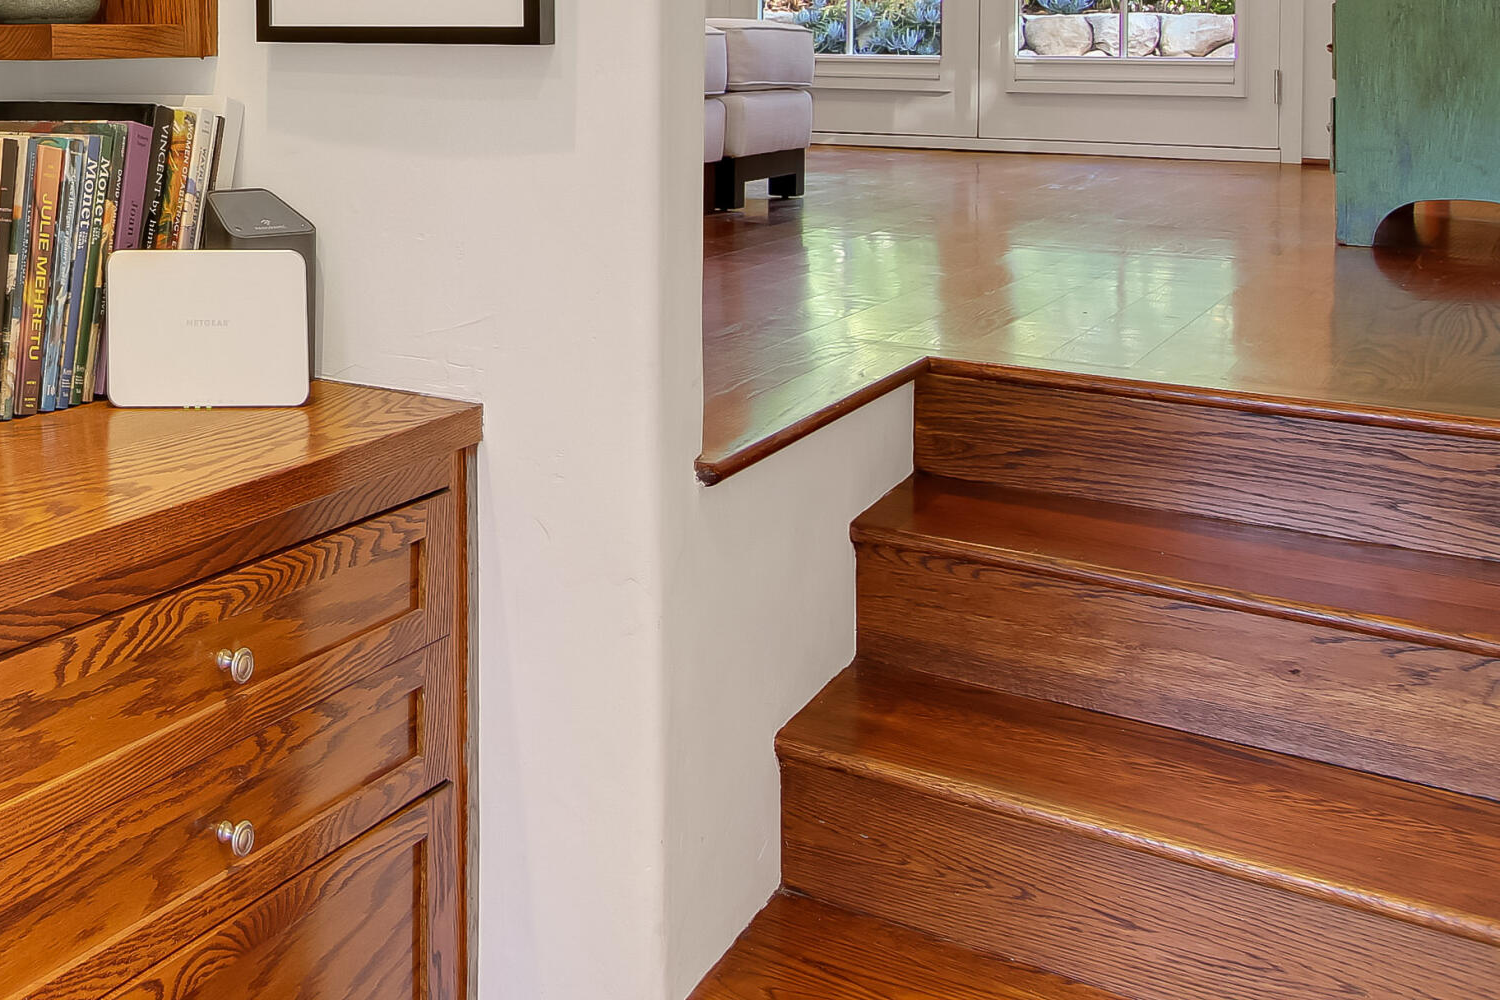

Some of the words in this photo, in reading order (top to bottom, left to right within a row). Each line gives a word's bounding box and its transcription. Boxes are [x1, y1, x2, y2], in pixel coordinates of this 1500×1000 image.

[154, 124, 170, 199] VINCENT
[183, 122, 194, 163] WOMEN
[114, 169, 122, 198] DAVID
[198, 147, 207, 182] WAYNE
[80, 157, 98, 229] Monet
[94, 156, 111, 226] Monet
[149, 200, 160, 215] by
[172, 182, 186, 238] ABSTRACT
[38, 193, 53, 251] JULIE
[128, 200, 139, 236] Joan
[146, 219, 158, 249] hims
[28, 256, 48, 361] MEHRETU
[186, 319, 229, 327] NETGEAR
